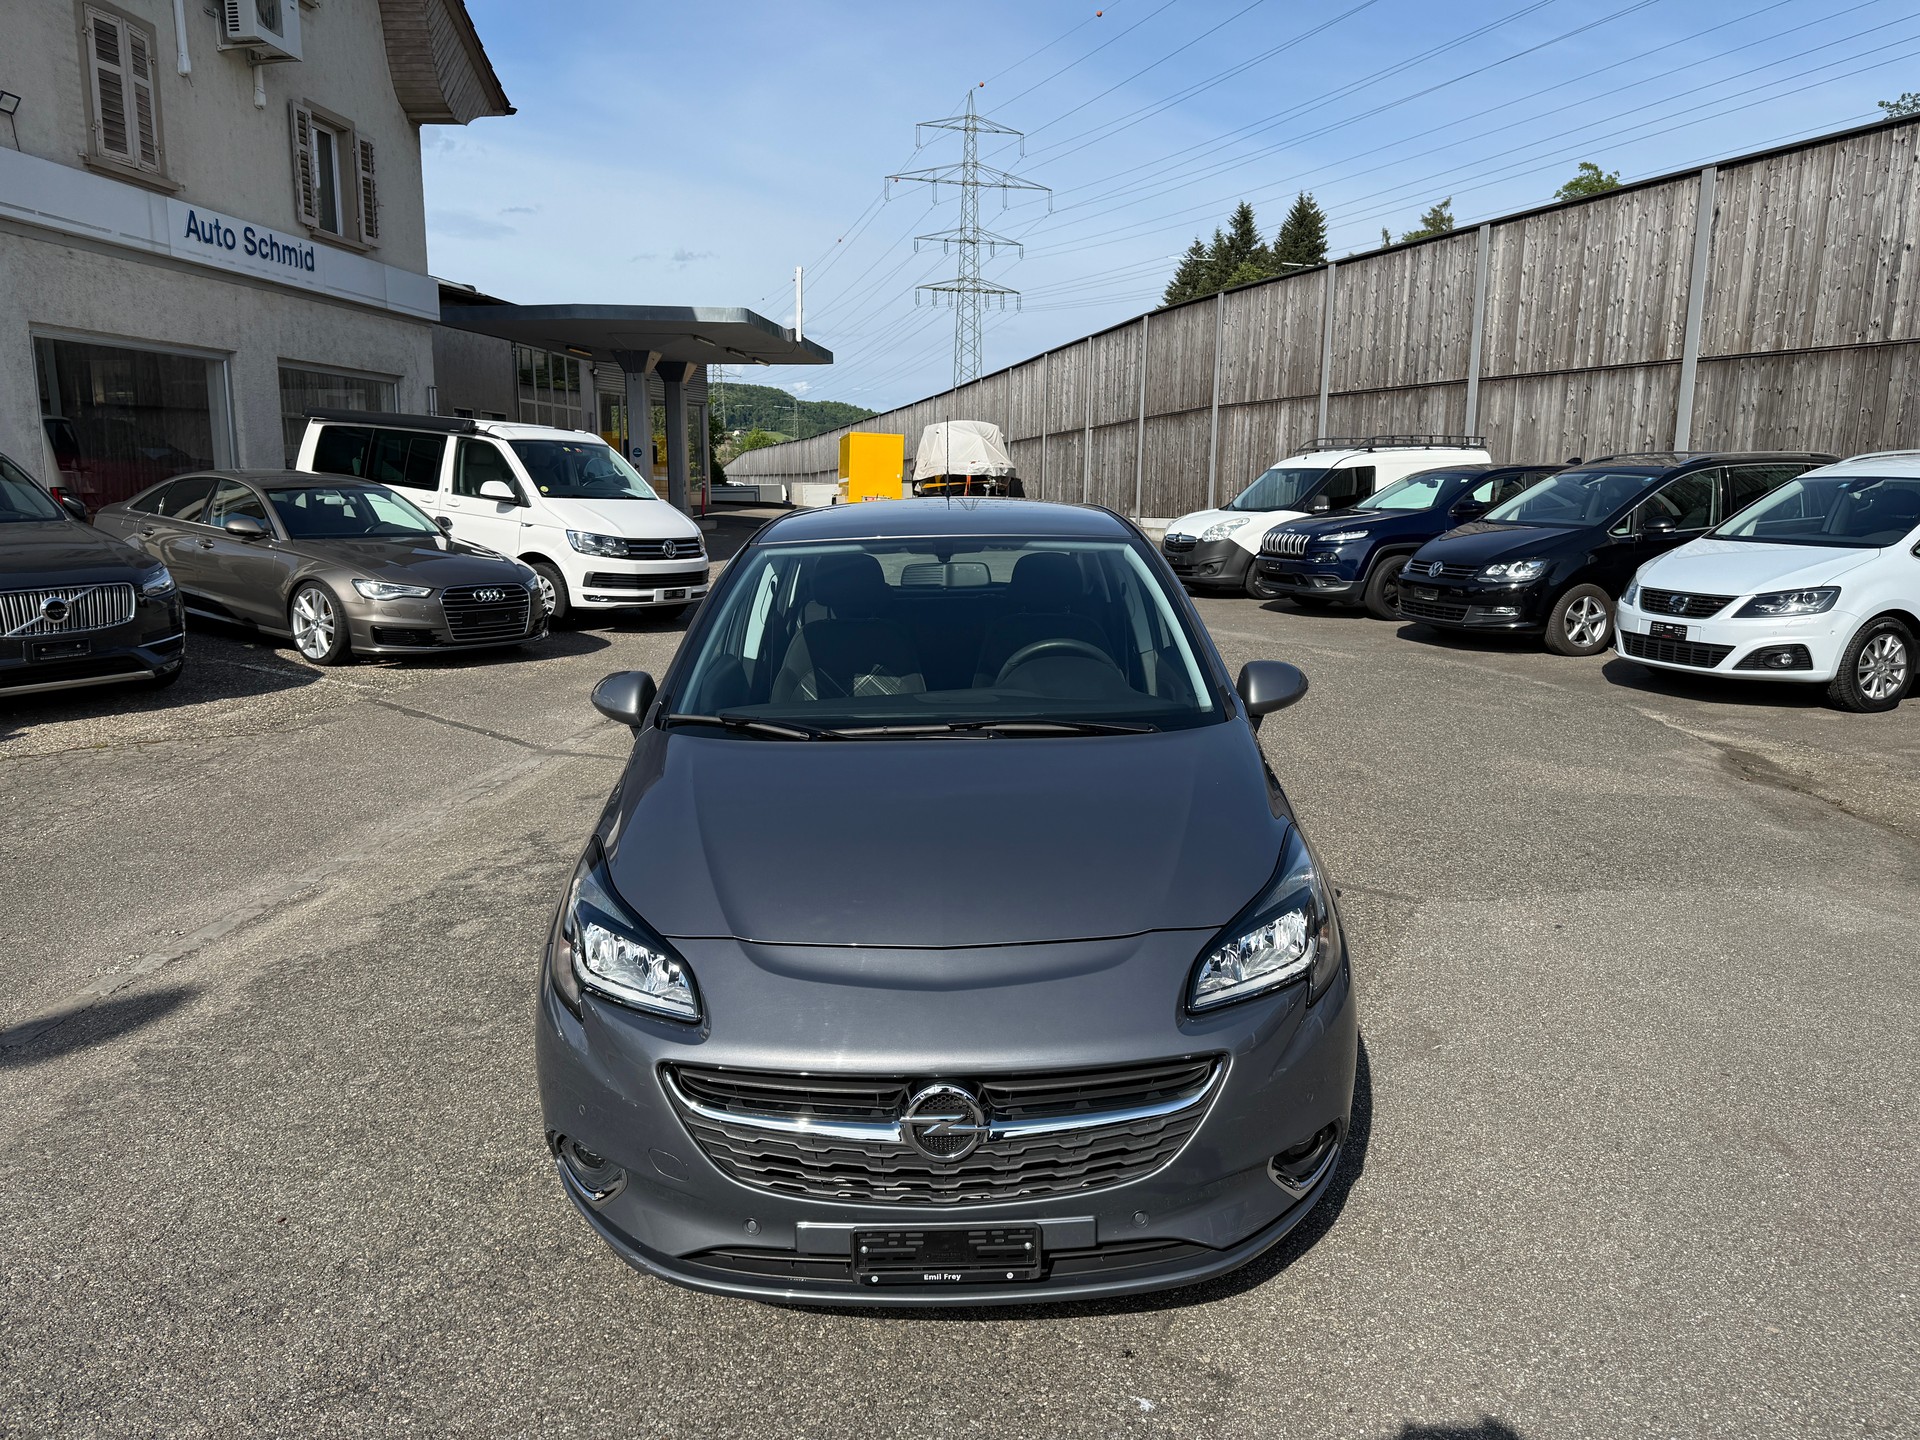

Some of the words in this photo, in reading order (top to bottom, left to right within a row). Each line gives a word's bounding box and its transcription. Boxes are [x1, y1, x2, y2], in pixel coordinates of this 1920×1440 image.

[184, 209, 236, 250] Auto
[243, 226, 315, 272] Schmid
[923, 1273, 942, 1281] Emil
[943, 1273, 961, 1281] Frey
